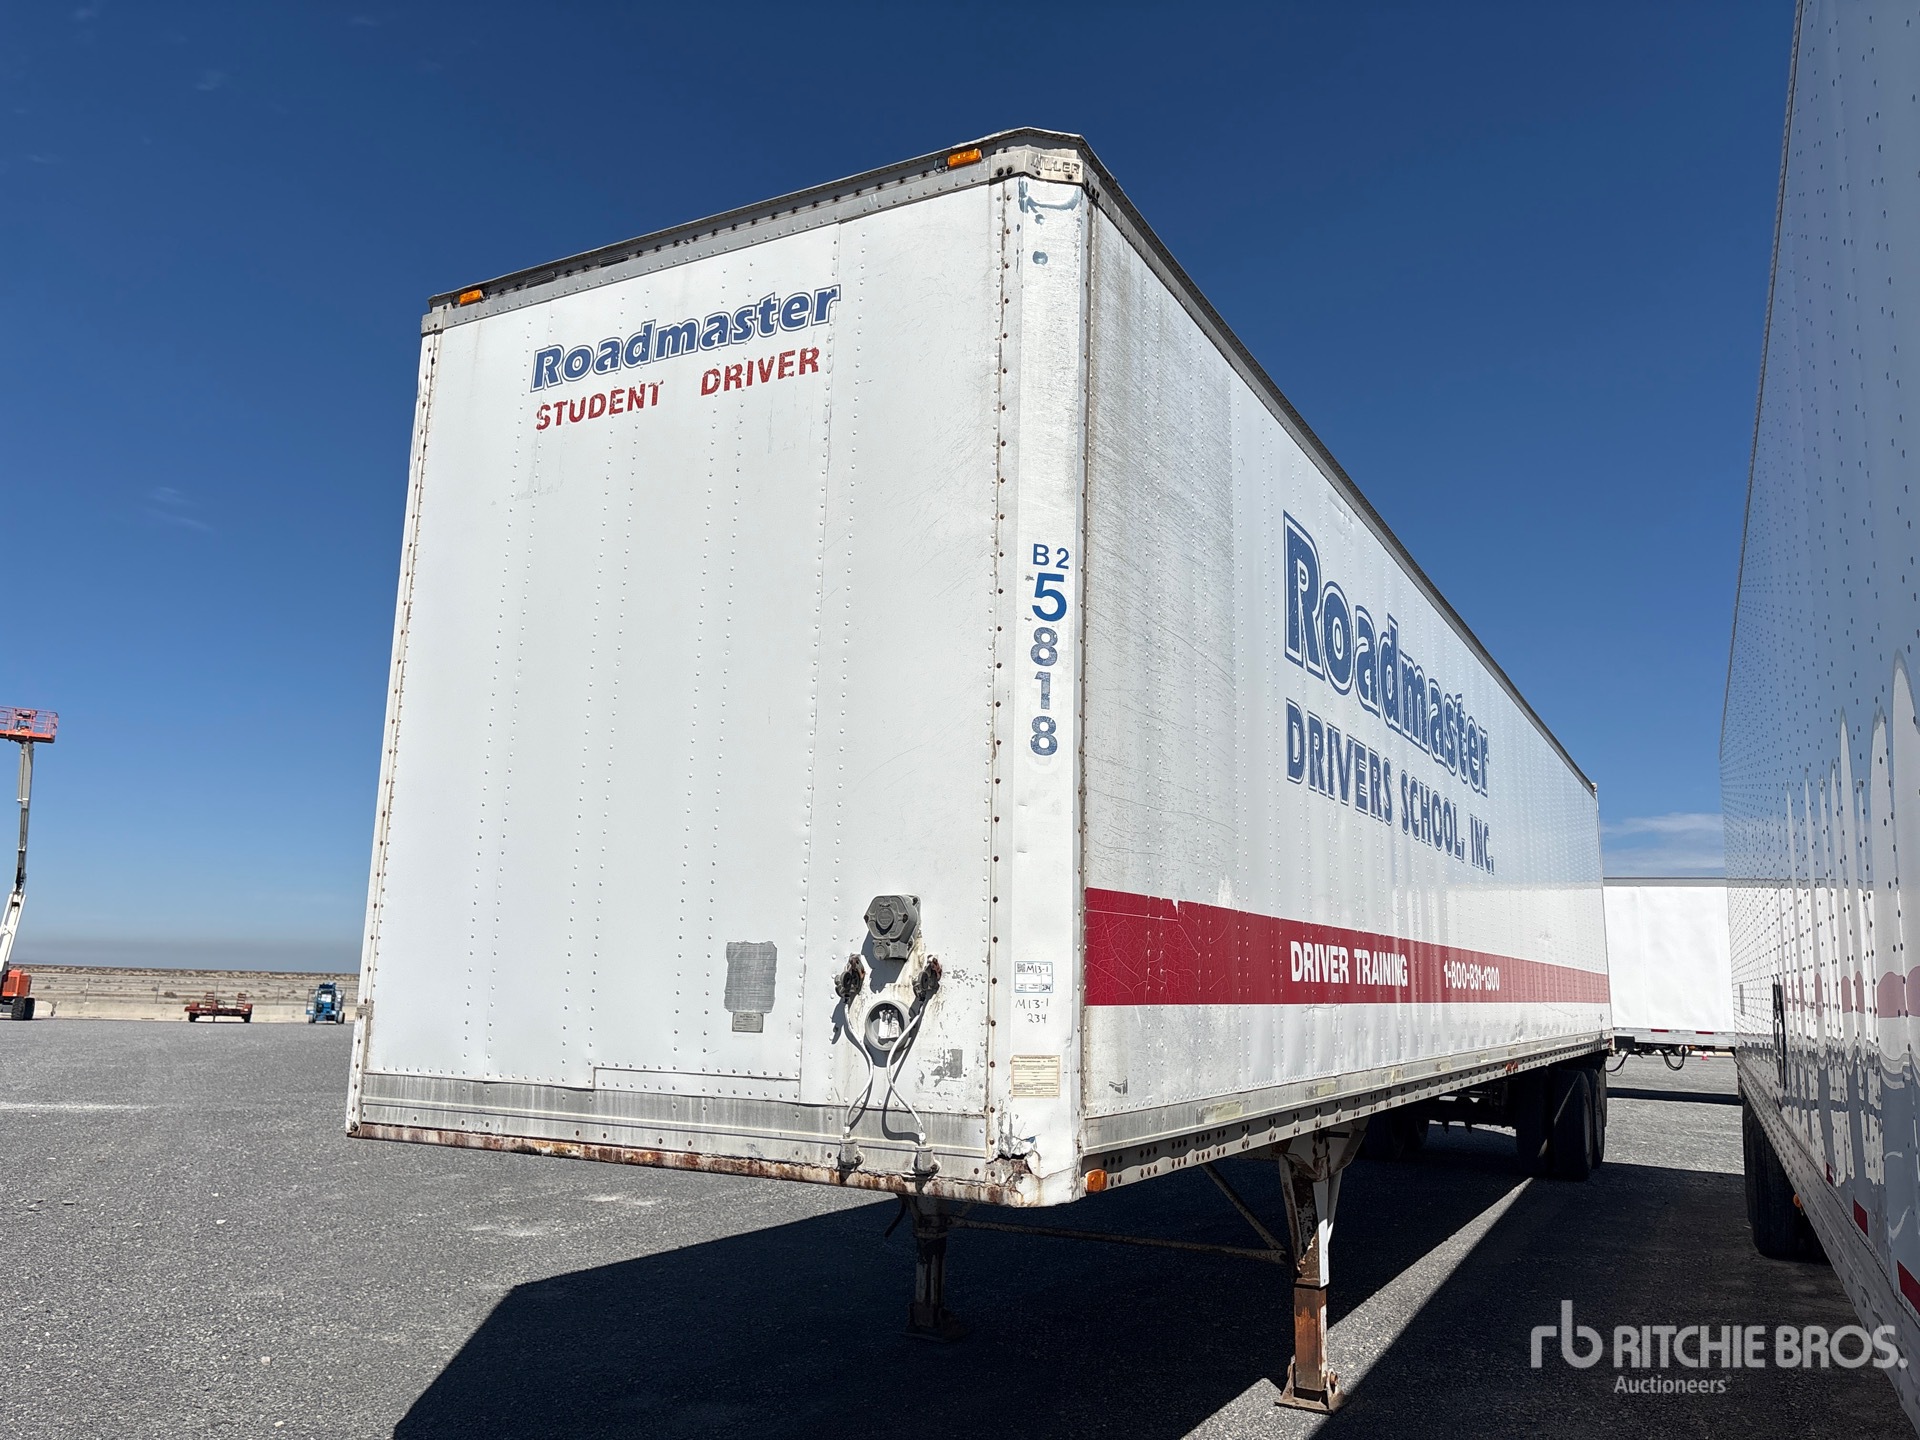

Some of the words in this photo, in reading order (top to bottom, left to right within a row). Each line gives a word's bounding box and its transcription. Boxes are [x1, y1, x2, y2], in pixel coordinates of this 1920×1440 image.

[530, 284, 841, 393] Roadmaster
[535, 379, 665, 432] STUDENT
[700, 346, 820, 397] DRIVER
[1283, 509, 1490, 798] Roadmaster
[1286, 697, 1392, 827] DRIVERS
[1401, 769, 1465, 863] SCHOOL,
[1470, 812, 1495, 876] INC.
[1015, 998, 1049, 1010] M13-1
[1290, 940, 1350, 984] DRIVER
[1354, 948, 1409, 987] TRAINING
[1443, 960, 1500, 991] 1-800-831-1300
[1026, 1012, 1047, 1024] 234
